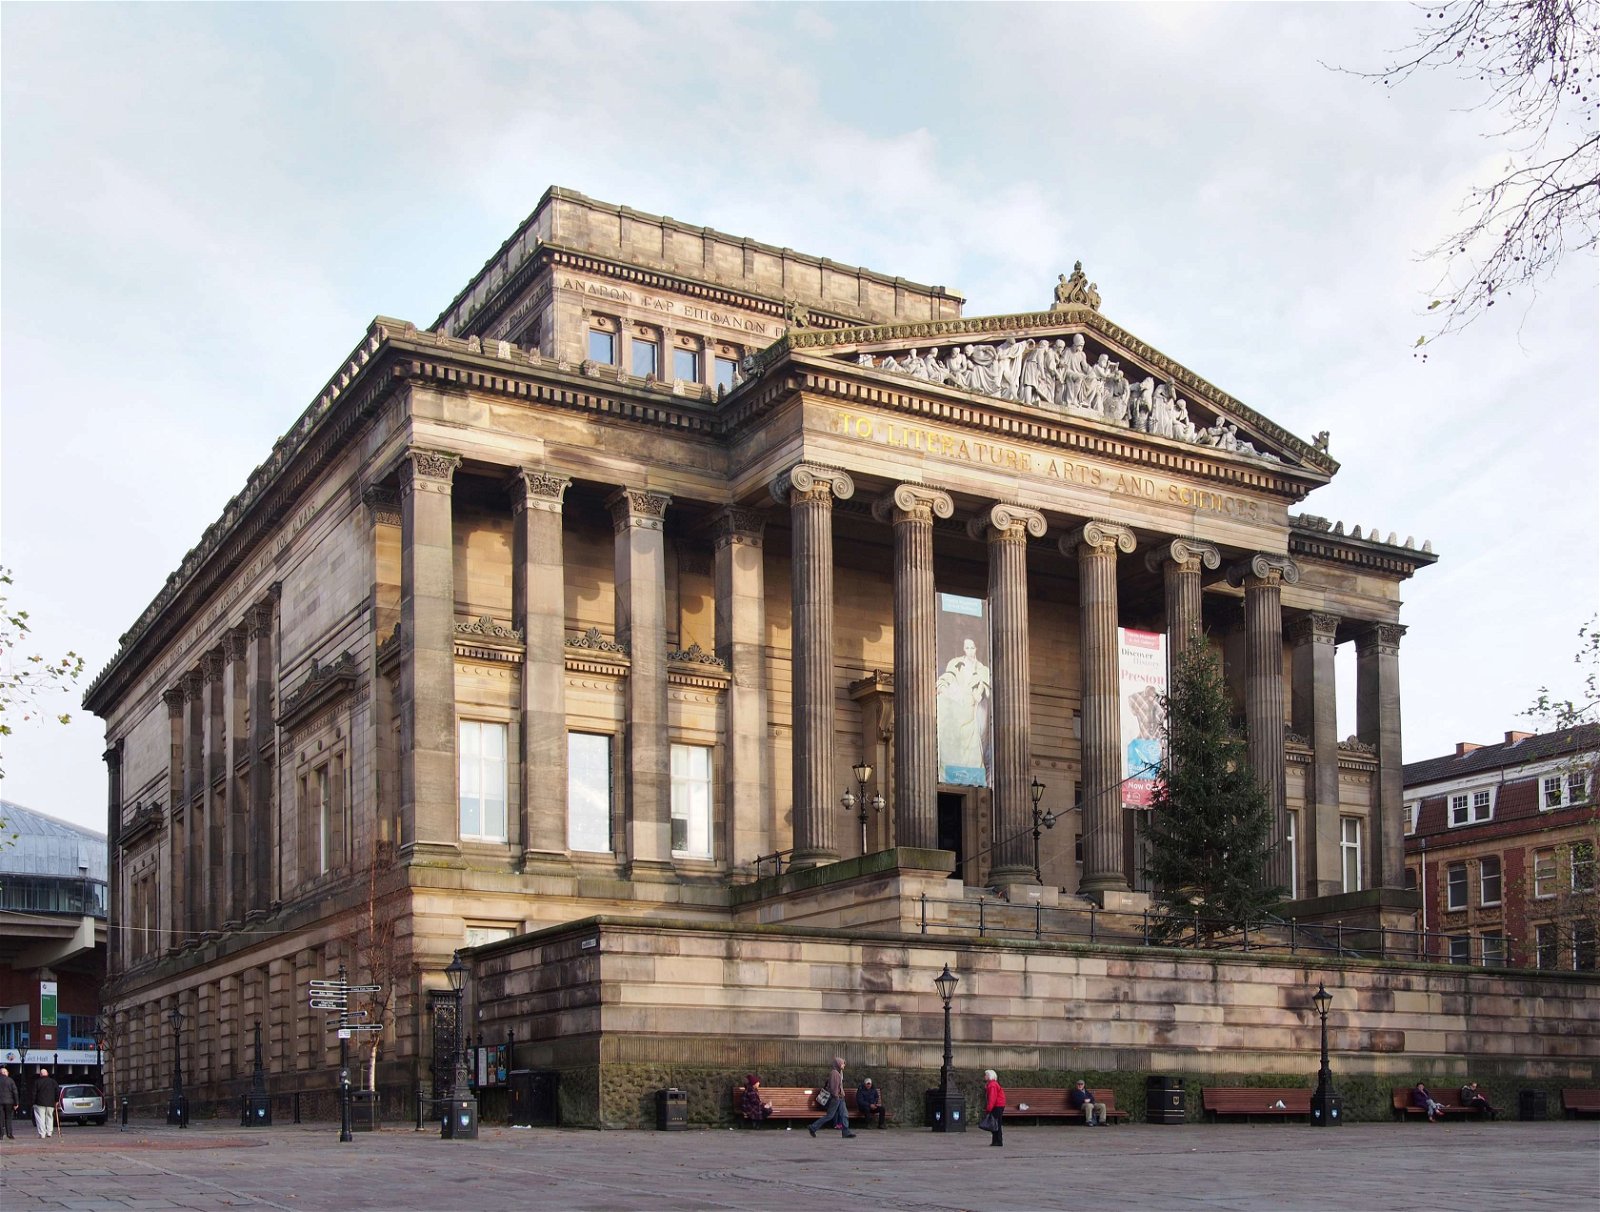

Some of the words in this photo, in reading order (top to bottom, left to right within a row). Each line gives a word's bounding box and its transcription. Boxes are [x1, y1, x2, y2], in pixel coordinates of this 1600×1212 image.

[839, 413, 873, 438] TO
[887, 424, 1032, 471] LITERATURE
[1048, 459, 1103, 485] ARTS
[1116, 474, 1155, 496] AND
[1168, 485, 1258, 520] SCIENCES
[1121, 648, 1154, 659] Discover
[1121, 669, 1164, 685] Preston
[1128, 782, 1144, 790] Now
